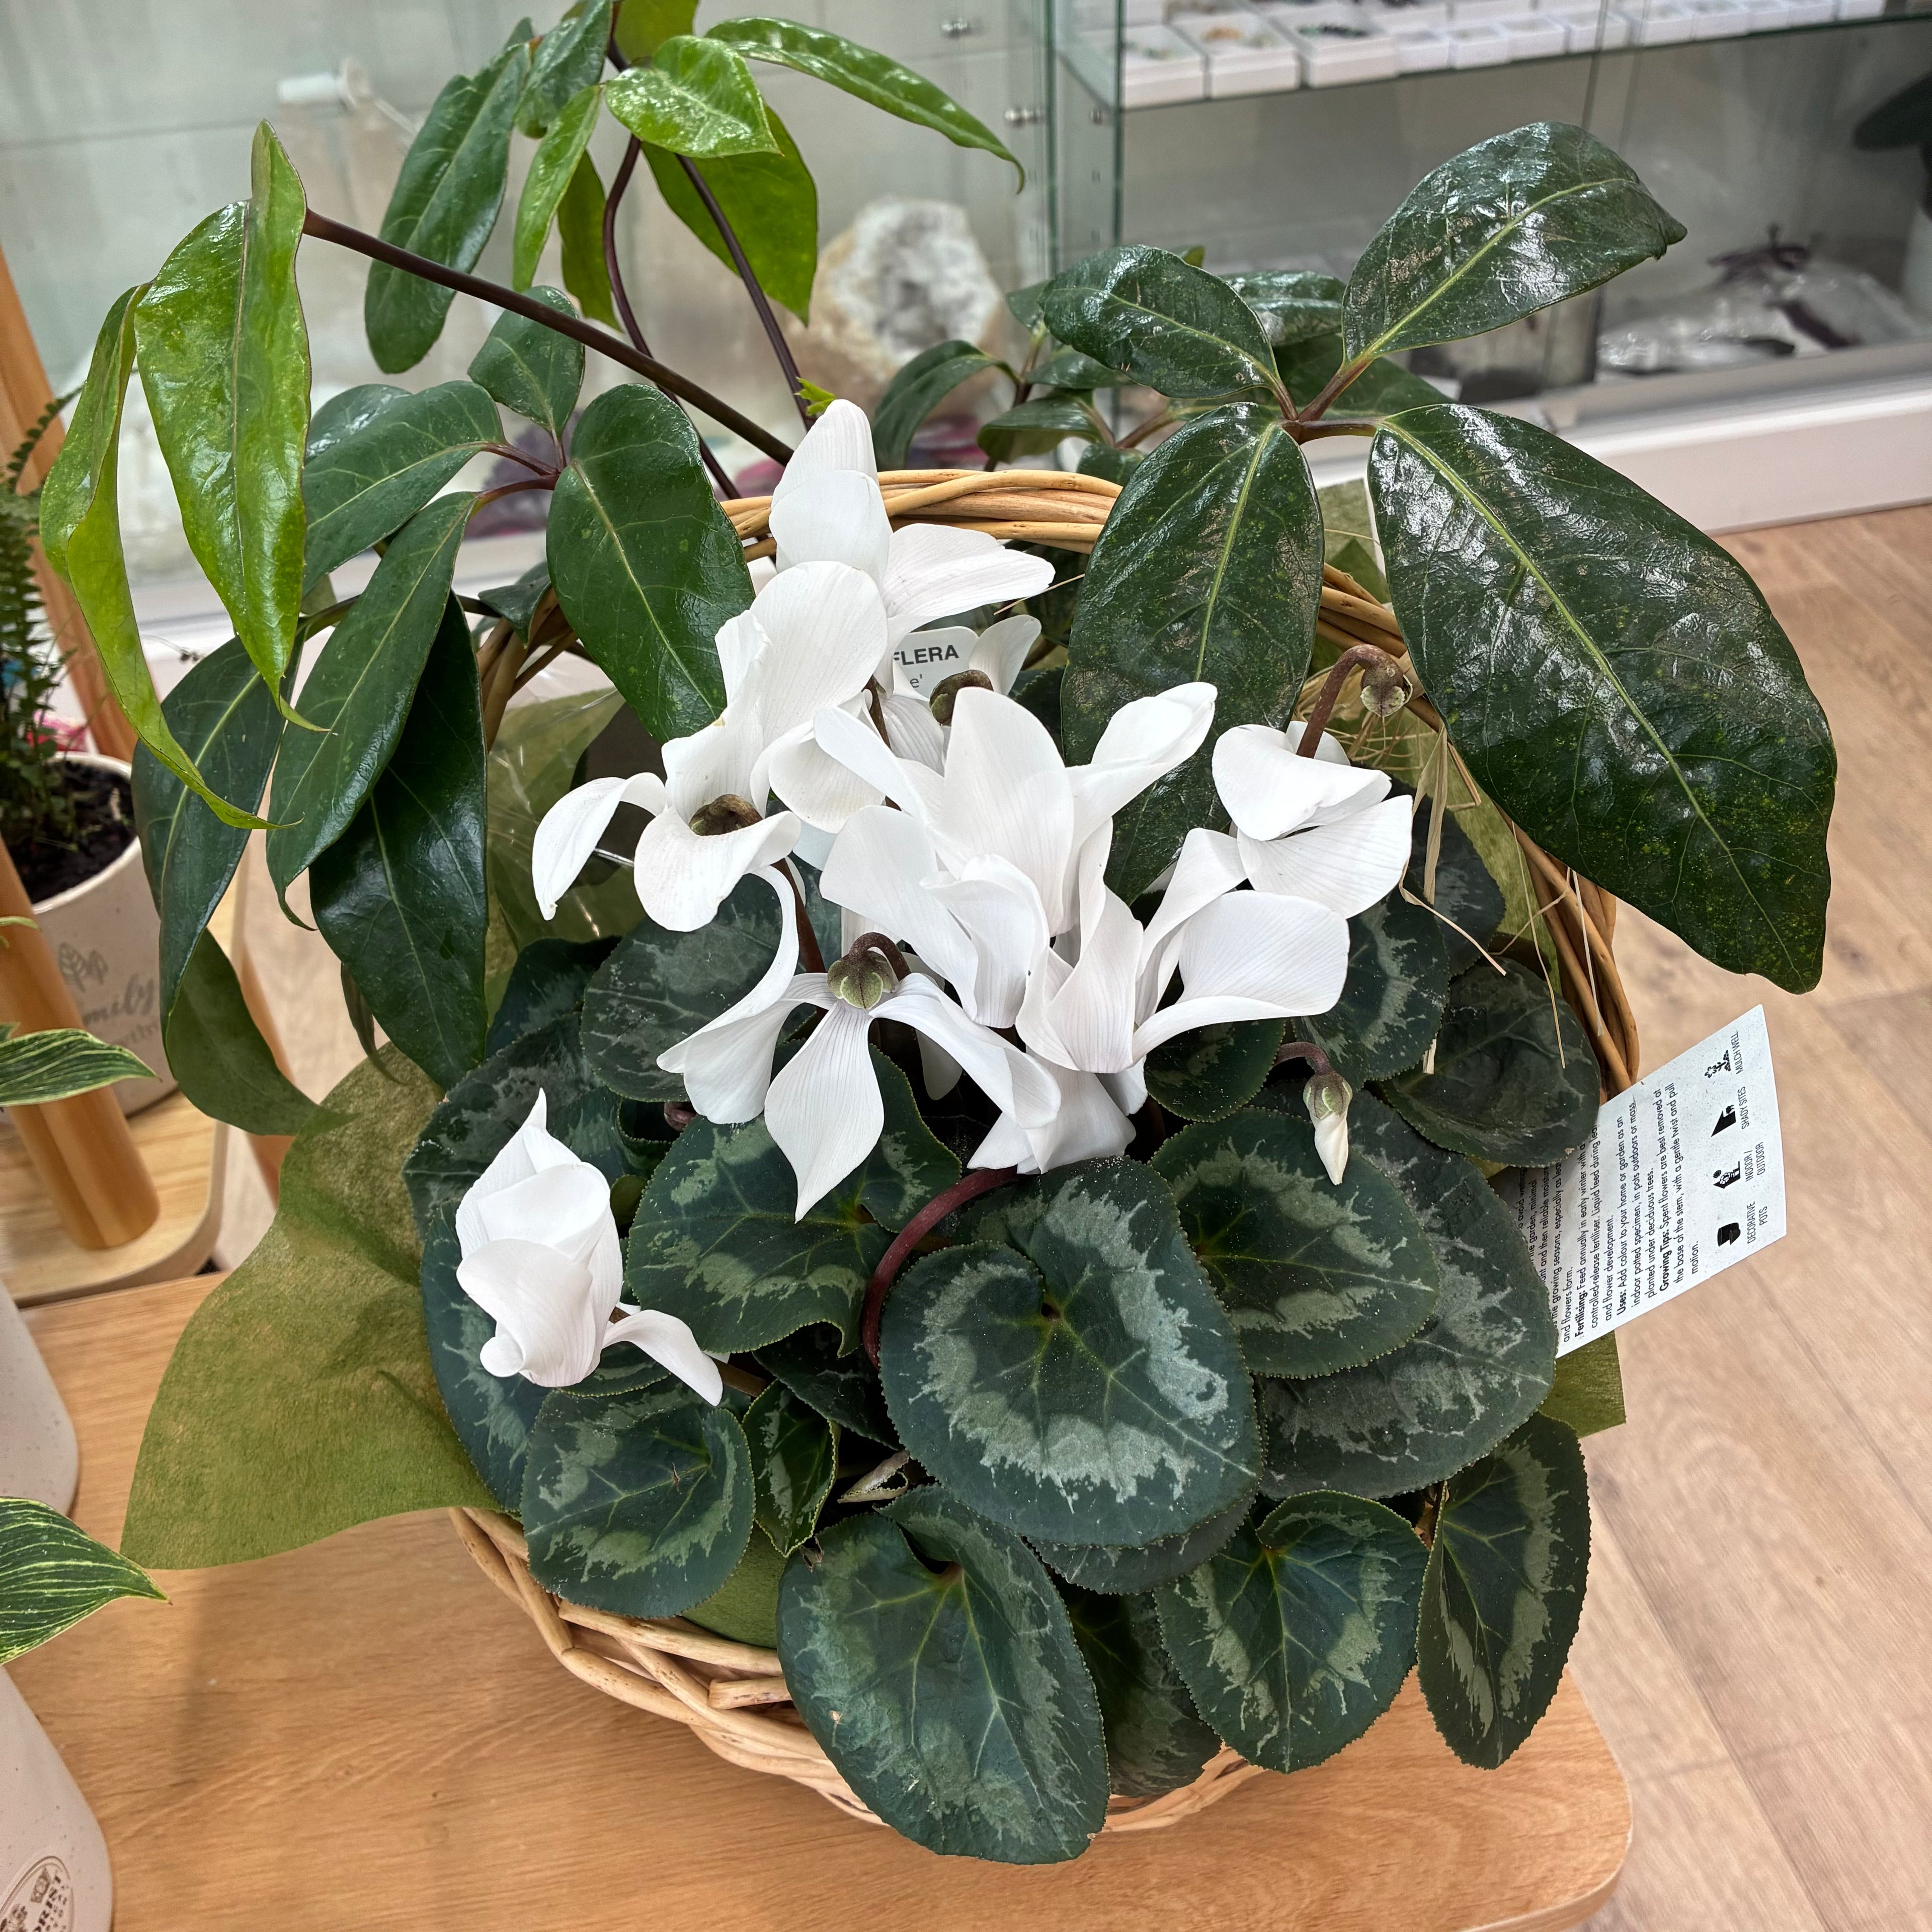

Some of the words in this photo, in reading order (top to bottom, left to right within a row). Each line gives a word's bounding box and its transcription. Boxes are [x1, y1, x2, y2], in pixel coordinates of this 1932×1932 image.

[1731, 1029, 1740, 1049] WELL
[1733, 1049, 1744, 1074] MULCH
[1653, 1088, 1662, 1097] at
[1665, 1082, 1678, 1098] pull
[1737, 1086, 1747, 1106] SITES
[1652, 1098, 1665, 1135] removed
[1667, 1099, 1677, 1116] and
[1740, 1105, 1750, 1129] SHADY
[1616, 1116, 1623, 1128] an
[1618, 1129, 1624, 1139] as
[1631, 1124, 1638, 1134] or
[1670, 1118, 1680, 1138] twist
[1590, 1140, 1601, 1168] during
[1616, 1140, 1629, 1170] garden
[1629, 1135, 1640, 1171] outdoors
[1656, 1135, 1666, 1156] best
[1670, 1138, 1684, 1164] gentle
[1755, 1141, 1766, 1175] OUTDOOR
[1577, 1151, 1586, 1169] with
[1744, 1154, 1754, 1182] INDOOR
[1556, 1178, 1562, 1187] as
[1578, 1171, 1587, 1196] winter
[1590, 1169, 1600, 1190] feed
[1620, 1172, 1626, 1181] or
[1633, 1172, 1643, 1191] pots
[1646, 1167, 1654, 1192] trees.
[1658, 1171, 1668, 1203] flowers
[1672, 1173, 1682, 1193] with
[1528, 1178, 1538, 1210] minimal
[1591, 1189, 1602, 1216] Liquid
[1617, 1182, 1627, 1209] home
[1632, 1192, 1641, 1202] in
[1675, 1193, 1684, 1216] stem,
[1515, 1198, 1525, 1221] avoid
[1540, 1198, 1550, 1229] reliable
[1553, 1189, 1564, 1229] especially
[1578, 1197, 1589, 1218] early
[1621, 1209, 1630, 1228] your
[1645, 1192, 1655, 1236] deciduous
[1659, 1201, 1672, 1229] Spent
[1759, 1205, 1768, 1226] POTS
[1526, 1211, 1538, 1242] garden,
[1579, 1220, 1587, 1229] in
[1590, 1216, 1601, 1253] fertiliser.
[1632, 1201, 1644, 1245] specimen,
[1673, 1218, 1684, 1233] the
[1747, 1200, 1756, 1244] DECORATIVE
[1539, 1230, 1549, 1249] then
[1554, 1230, 1562, 1266] seasons,
[1577, 1230, 1589, 1265] annually
[1603, 1215, 1616, 1272] development.
[1645, 1237, 1655, 1263] under
[1660, 1228, 1672, 1252] Tips:
[1673, 1233, 1684, 1243] of
[1539, 1250, 1548, 1266] and
[1617, 1240, 1627, 1266] colour
[1631, 1246, 1644, 1274] potted
[1673, 1244, 1684, 1269] base
[1689, 1240, 1699, 1274] motion.
[1563, 1266, 1573, 1291] form.
[1576, 1266, 1586, 1290] Feed
[1618, 1268, 1627, 1287] Add
[1645, 1264, 1657, 1298] planted
[1659, 1250, 1672, 1291] Growing
[1673, 1267, 1684, 1283] the
[1551, 1266, 1562, 1304] growing
[1589, 1253, 1600, 1328] controlled-release
[1603, 1274, 1613, 1303] flower
[1631, 1277, 1641, 1307] indoor
[1561, 1291, 1573, 1325] flowers
[1575, 1290, 1588, 1337] Fertilising:
[1602, 1302, 1613, 1321] and
[1617, 1289, 1627, 1315] Uses:
[1561, 1324, 1571, 1342] and
